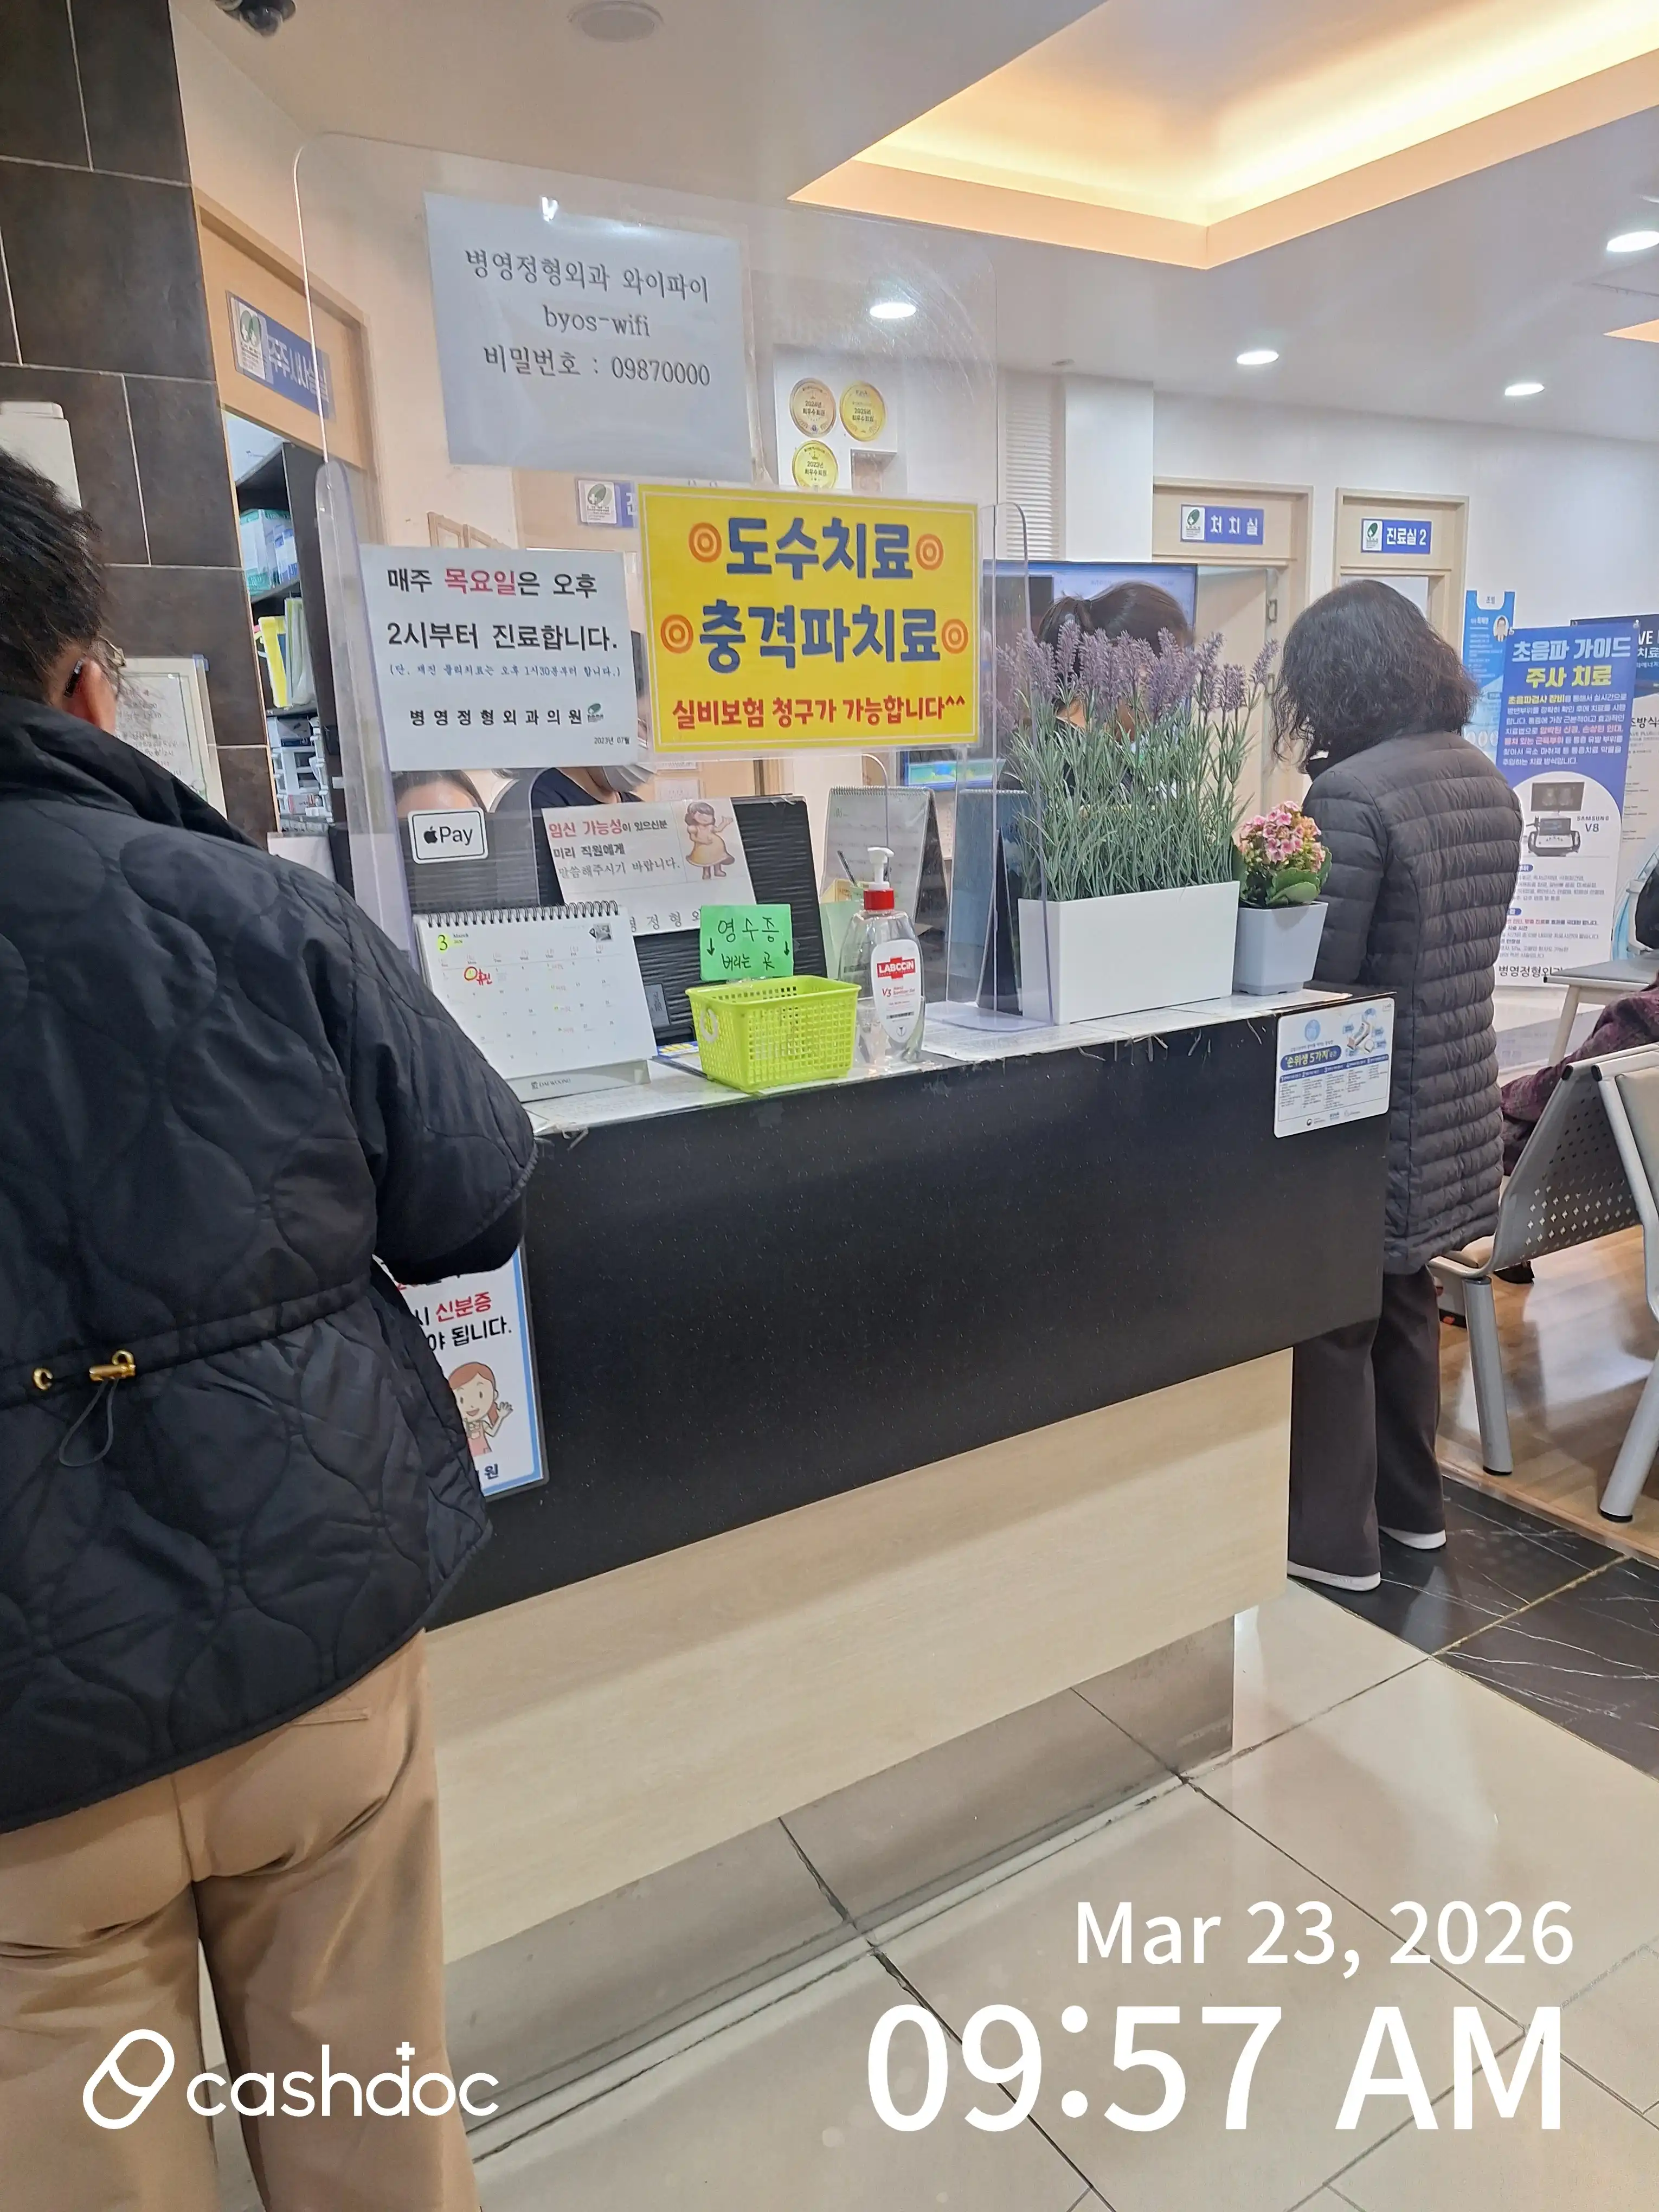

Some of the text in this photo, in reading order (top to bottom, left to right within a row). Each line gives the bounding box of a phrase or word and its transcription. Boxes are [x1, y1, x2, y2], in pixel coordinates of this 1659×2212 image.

[465, 249, 709, 303] 병영정형외과 와이파이
[542, 304, 651, 337] byos-wifi
[483, 345, 581, 376] 비밀번호
[610, 356, 710, 387] 09870000
[726, 517, 913, 580] 도수치료
[1386, 527, 1417, 545] 진료실
[1419, 529, 1427, 545] 2
[387, 568, 597, 599] 매주 목요일은 오후
[387, 622, 618, 652] 2시부터 진료합니다.
[699, 599, 941, 674] 충격파치료
[1512, 640, 1570, 663] 초음파
[1573, 636, 1631, 660] 가이드
[1526, 665, 1612, 689] 주사 치료
[672, 699, 765, 730] 실비보험
[771, 697, 837, 728] 청구가
[439, 826, 473, 846] Pay
[549, 818, 668, 839] 임신 가능성이 있으신분
[1585, 823, 1600, 833] V8
[553, 842, 626, 859] 미리 직원에게
[438, 934, 448, 950] 3
[717, 916, 780, 943] 영수증
[721, 951, 775, 973] 버리는 곳
[882, 988, 892, 998] V3
[435, 1292, 492, 1323] 신분증
[452, 1315, 512, 1347] 됩니다.
[484, 1463, 499, 1480] 원
